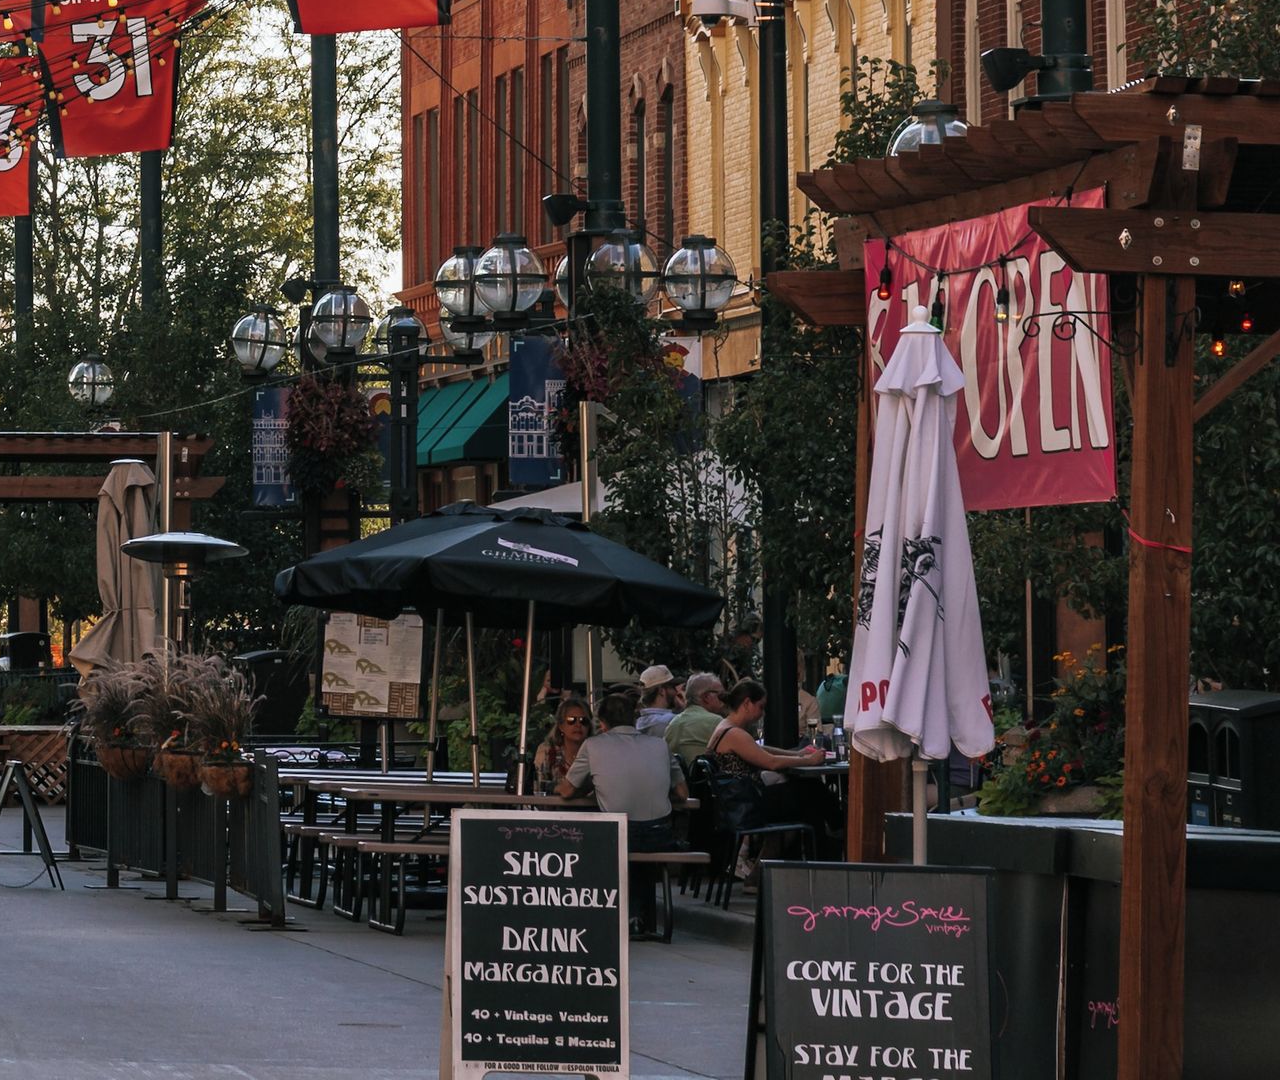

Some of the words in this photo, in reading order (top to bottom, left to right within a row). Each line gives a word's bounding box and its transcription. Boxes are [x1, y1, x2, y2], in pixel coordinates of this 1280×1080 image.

[71, 15, 154, 102] 31
[960, 250, 1110, 460] OPEN
[503, 851, 580, 877] SHOP
[463, 885, 618, 908] SUSTAINABLY
[501, 926, 589, 954] DRINK
[463, 961, 618, 988] MARGARITAS
[786, 960, 857, 982] COME
[868, 962, 915, 984] FOR
[920, 963, 965, 986] THE
[471, 1009, 490, 1020] 40
[504, 1009, 553, 1024] Vintage
[558, 1011, 609, 1023] Vendors
[811, 988, 953, 1021] VINTAGE
[463, 1032, 483, 1043] 40
[496, 1033, 550, 1048] Tequilas
[568, 1037, 616, 1049] Mezcals
[536, 1063, 559, 1071] FOLLOW
[794, 1043, 859, 1067] STAY
[870, 1046, 917, 1069] FOR
[928, 1048, 973, 1071] THE
